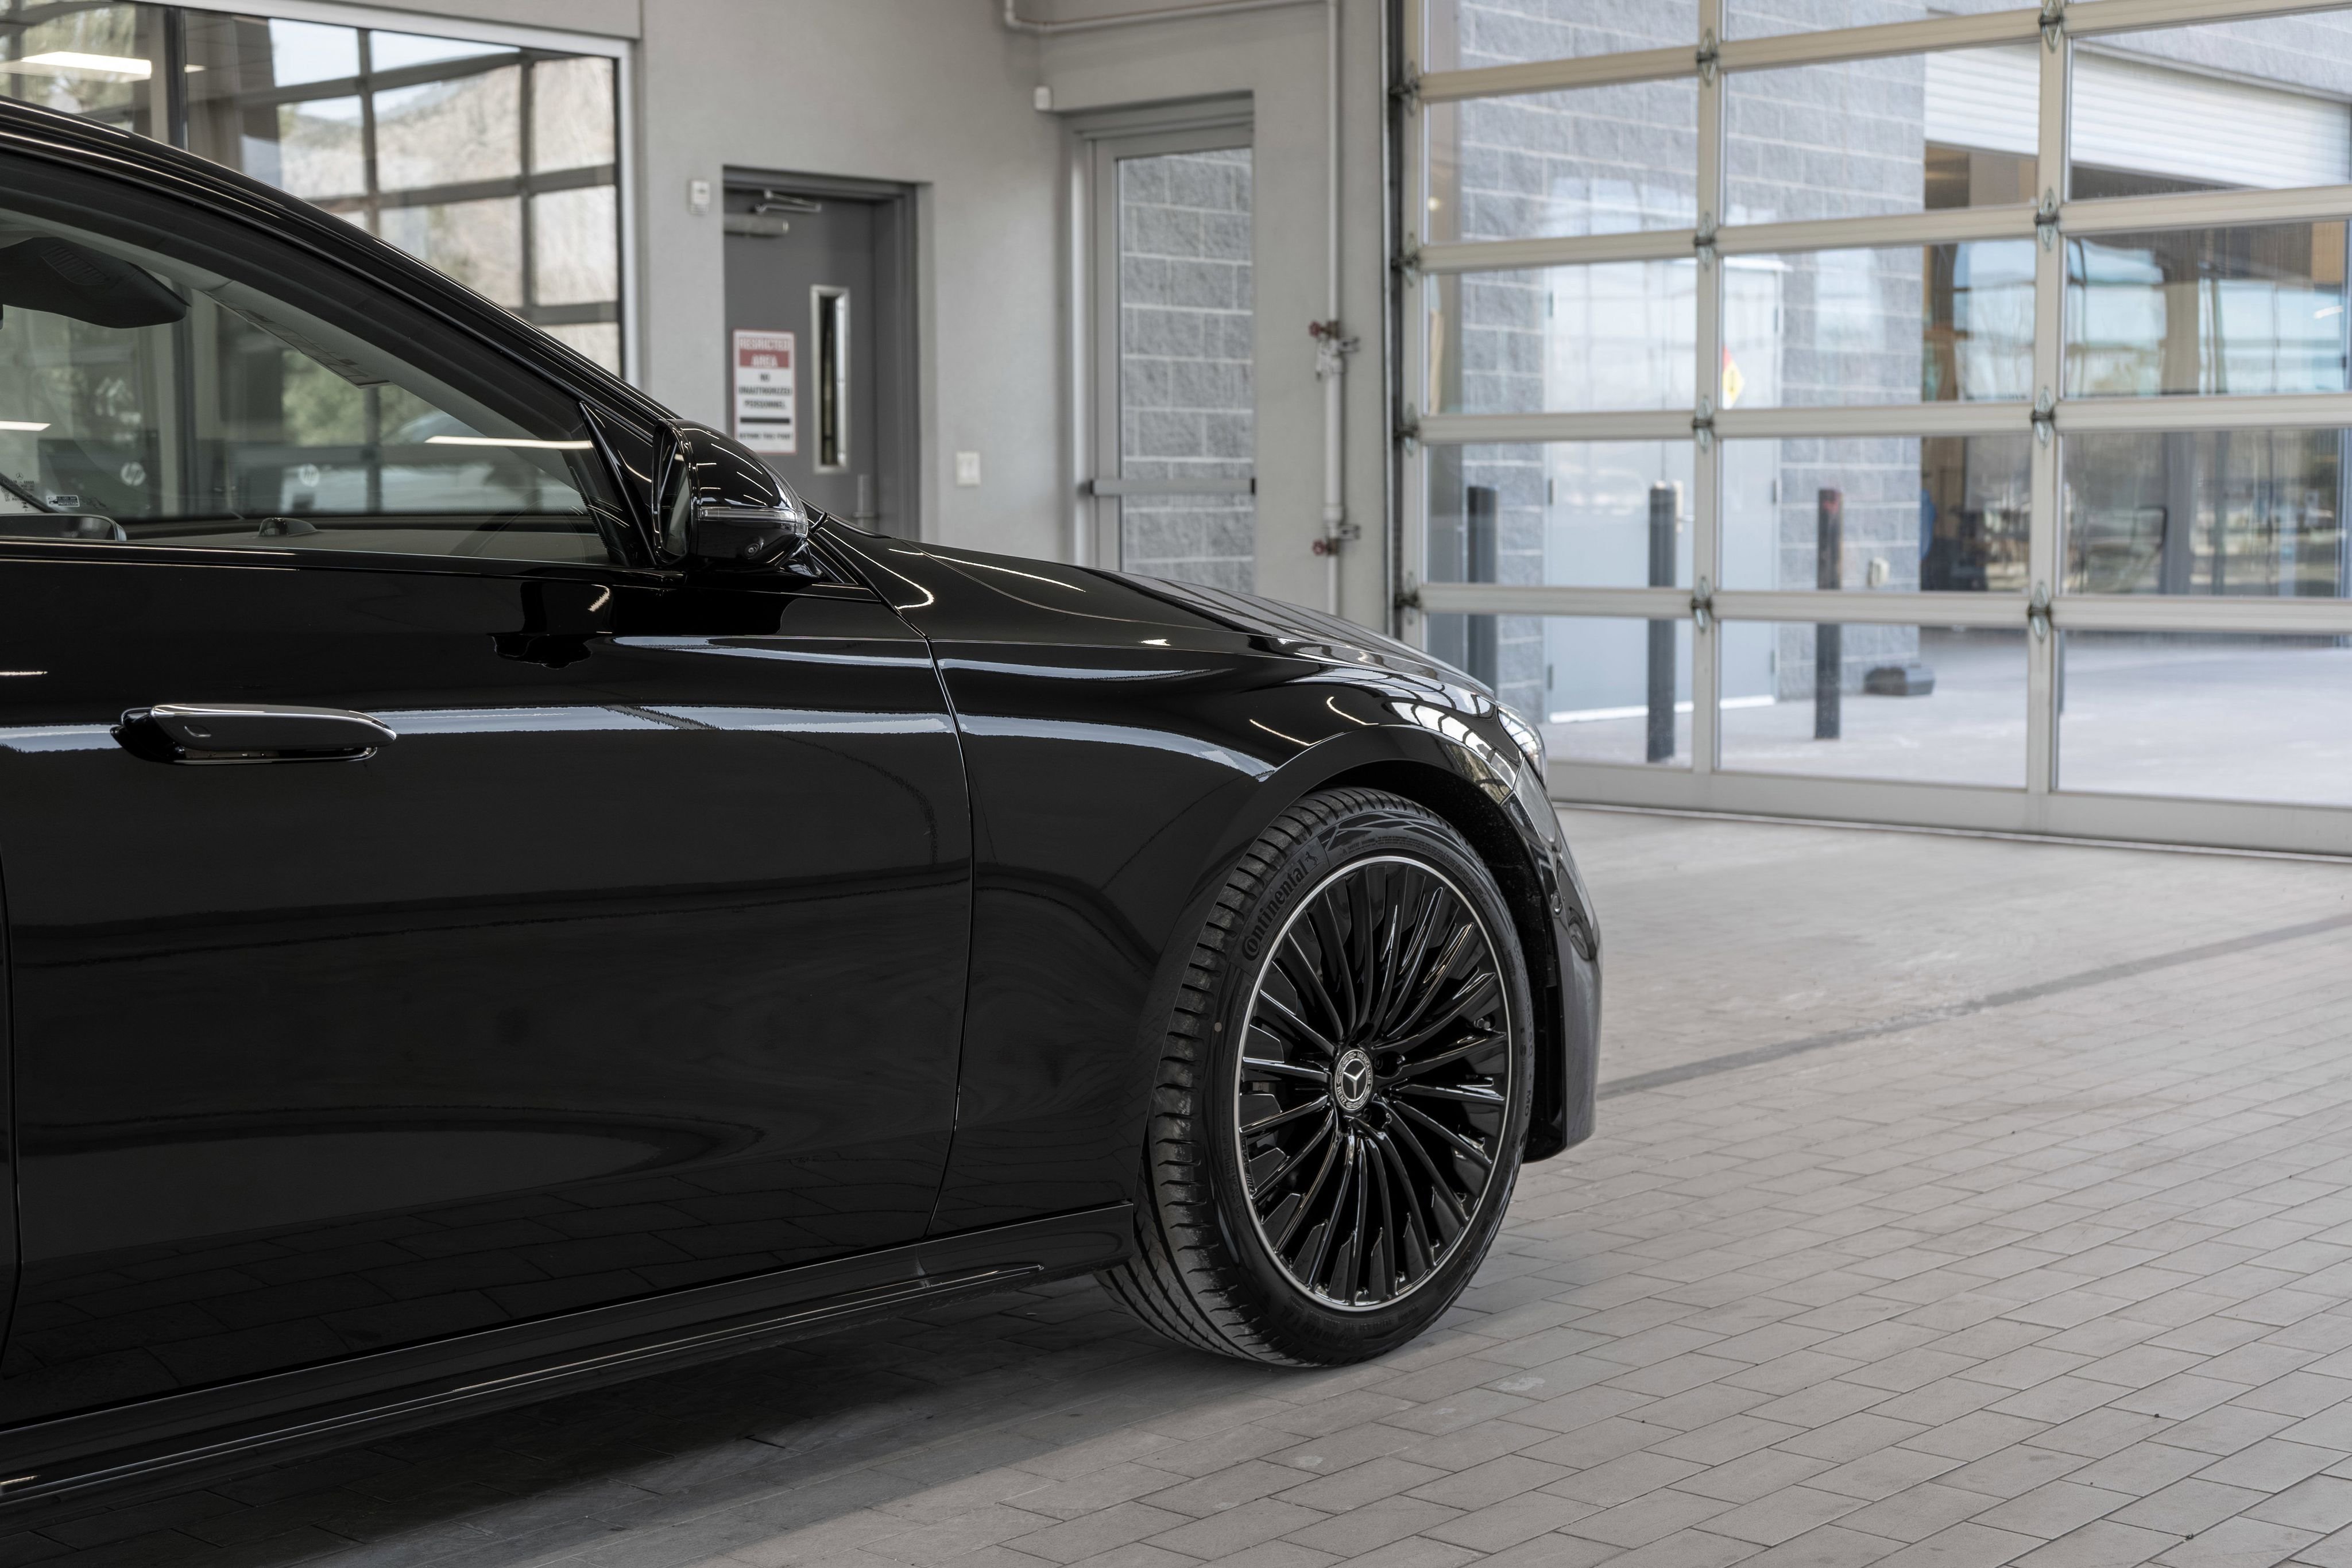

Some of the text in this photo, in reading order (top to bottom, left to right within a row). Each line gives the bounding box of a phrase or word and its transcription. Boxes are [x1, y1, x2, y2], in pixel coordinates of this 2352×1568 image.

[750, 354, 778, 367] AREA
[1241, 859, 1310, 962] Continental
[1357, 1051, 1372, 1085] MERCEDES
[1337, 1086, 1347, 1104] BENZ
